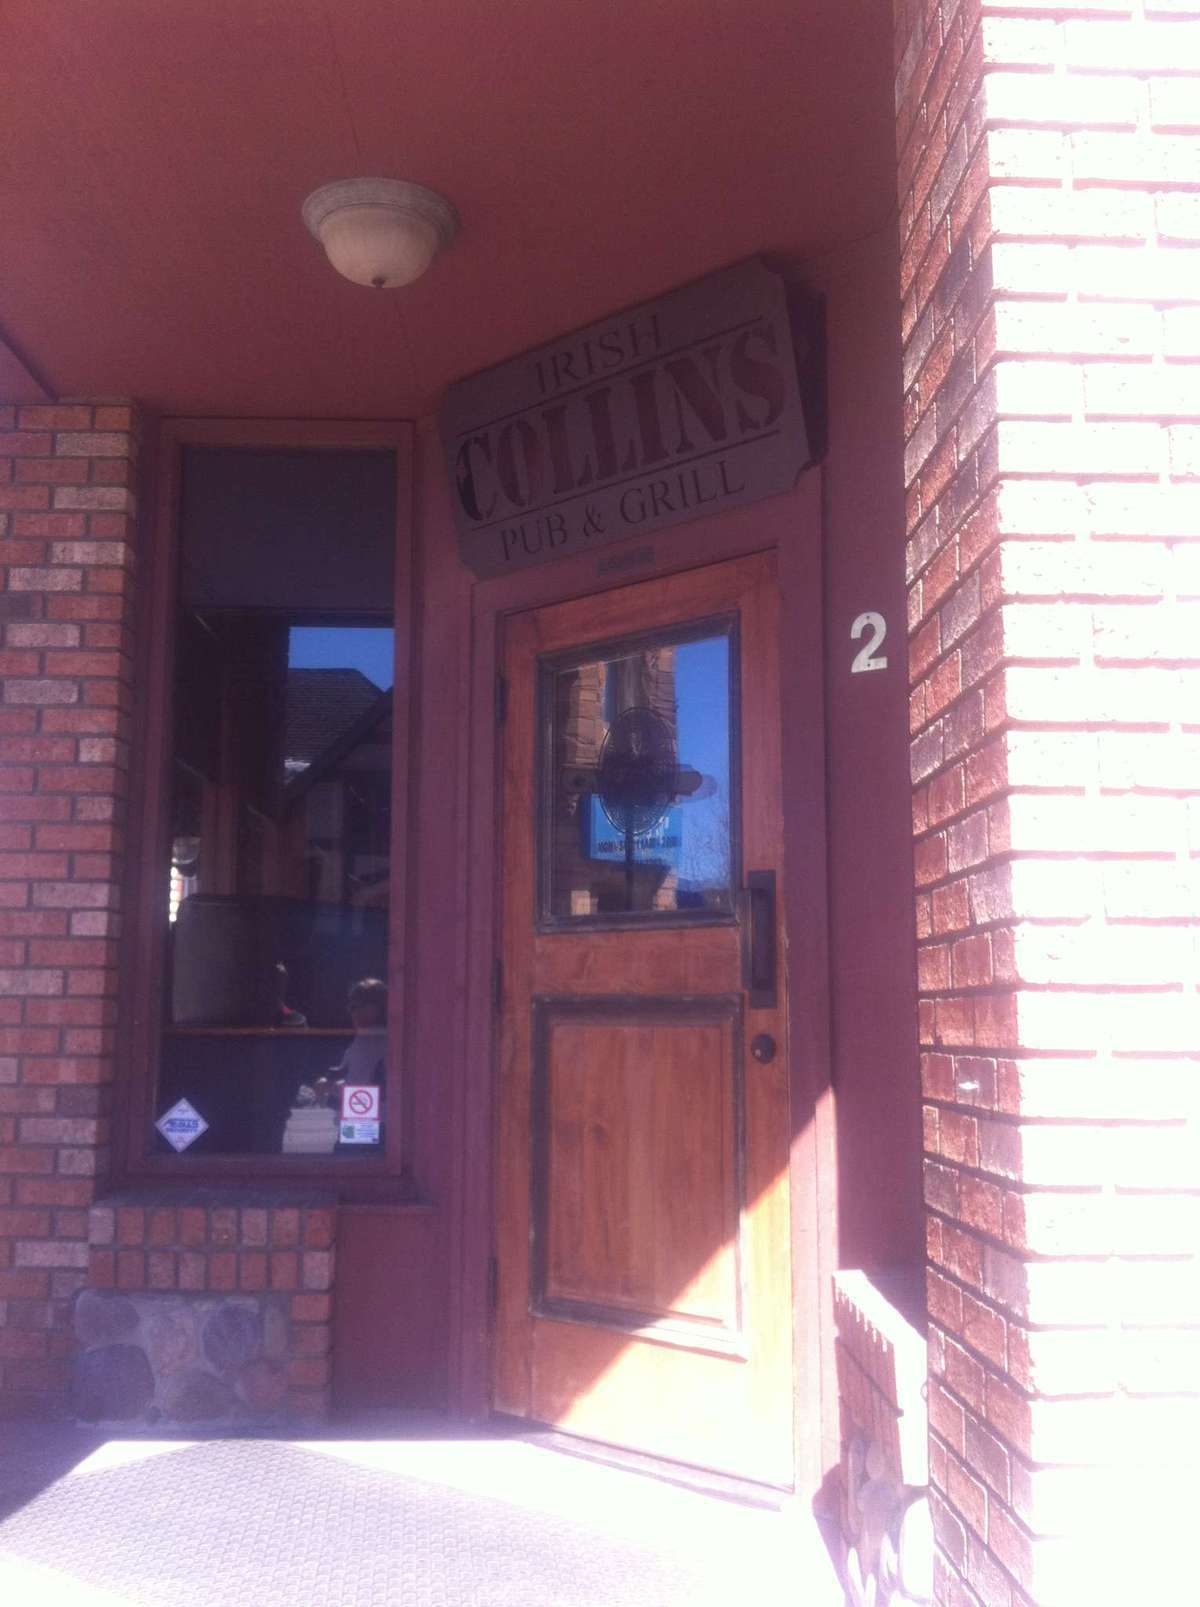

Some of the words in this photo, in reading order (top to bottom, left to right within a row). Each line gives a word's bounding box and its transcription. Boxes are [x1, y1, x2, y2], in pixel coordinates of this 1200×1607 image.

[534, 314, 664, 394] IRISH
[455, 323, 787, 521] COLLINS
[501, 513, 569, 561] PUB
[582, 506, 607, 538] &
[619, 460, 745, 525] GRILL
[850, 611, 888, 674] 2
